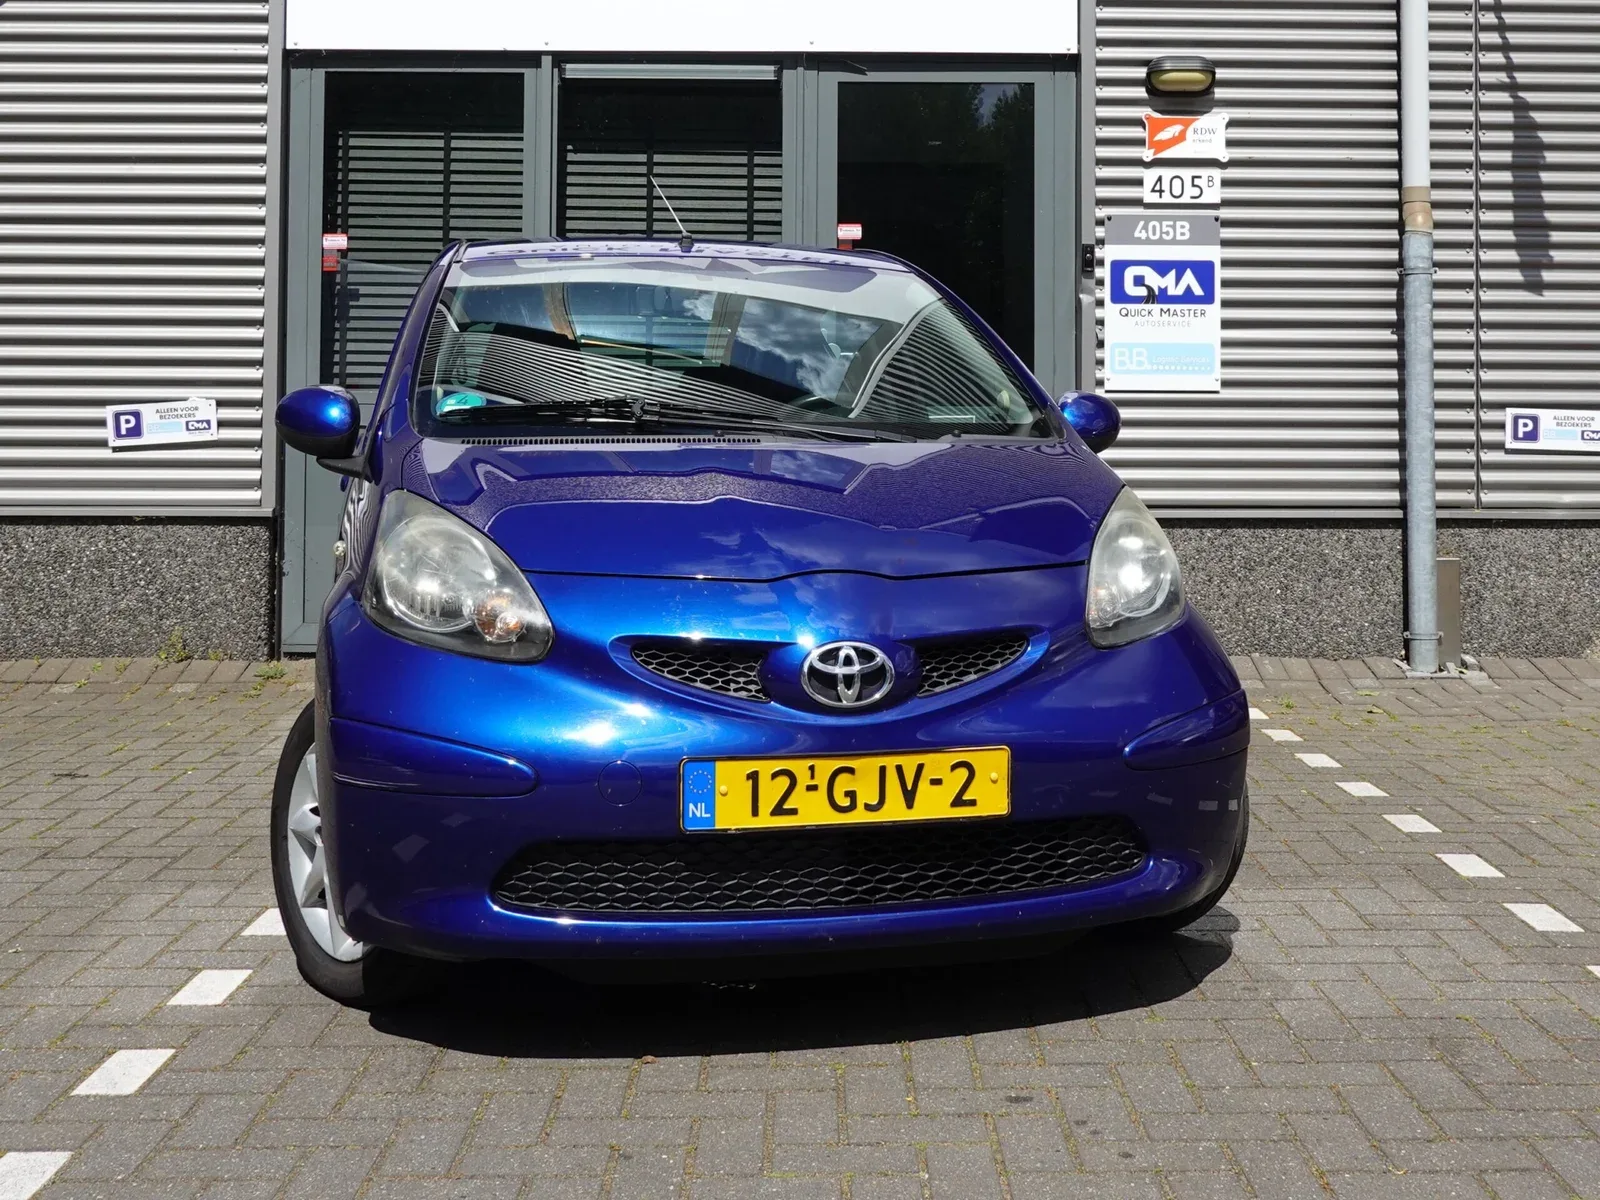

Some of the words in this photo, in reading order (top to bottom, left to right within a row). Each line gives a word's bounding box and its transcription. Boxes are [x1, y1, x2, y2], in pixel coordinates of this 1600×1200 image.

[1192, 127, 1218, 136] RDW
[1133, 220, 1191, 240] 405B
[1124, 265, 1205, 298] QMA
[1119, 307, 1154, 318] QUICK
[1160, 307, 1207, 318] MASTER
[120, 414, 136, 435] P
[159, 412, 197, 420] BEZOEKERS
[1517, 418, 1534, 438] P
[688, 802, 711, 818] NL
